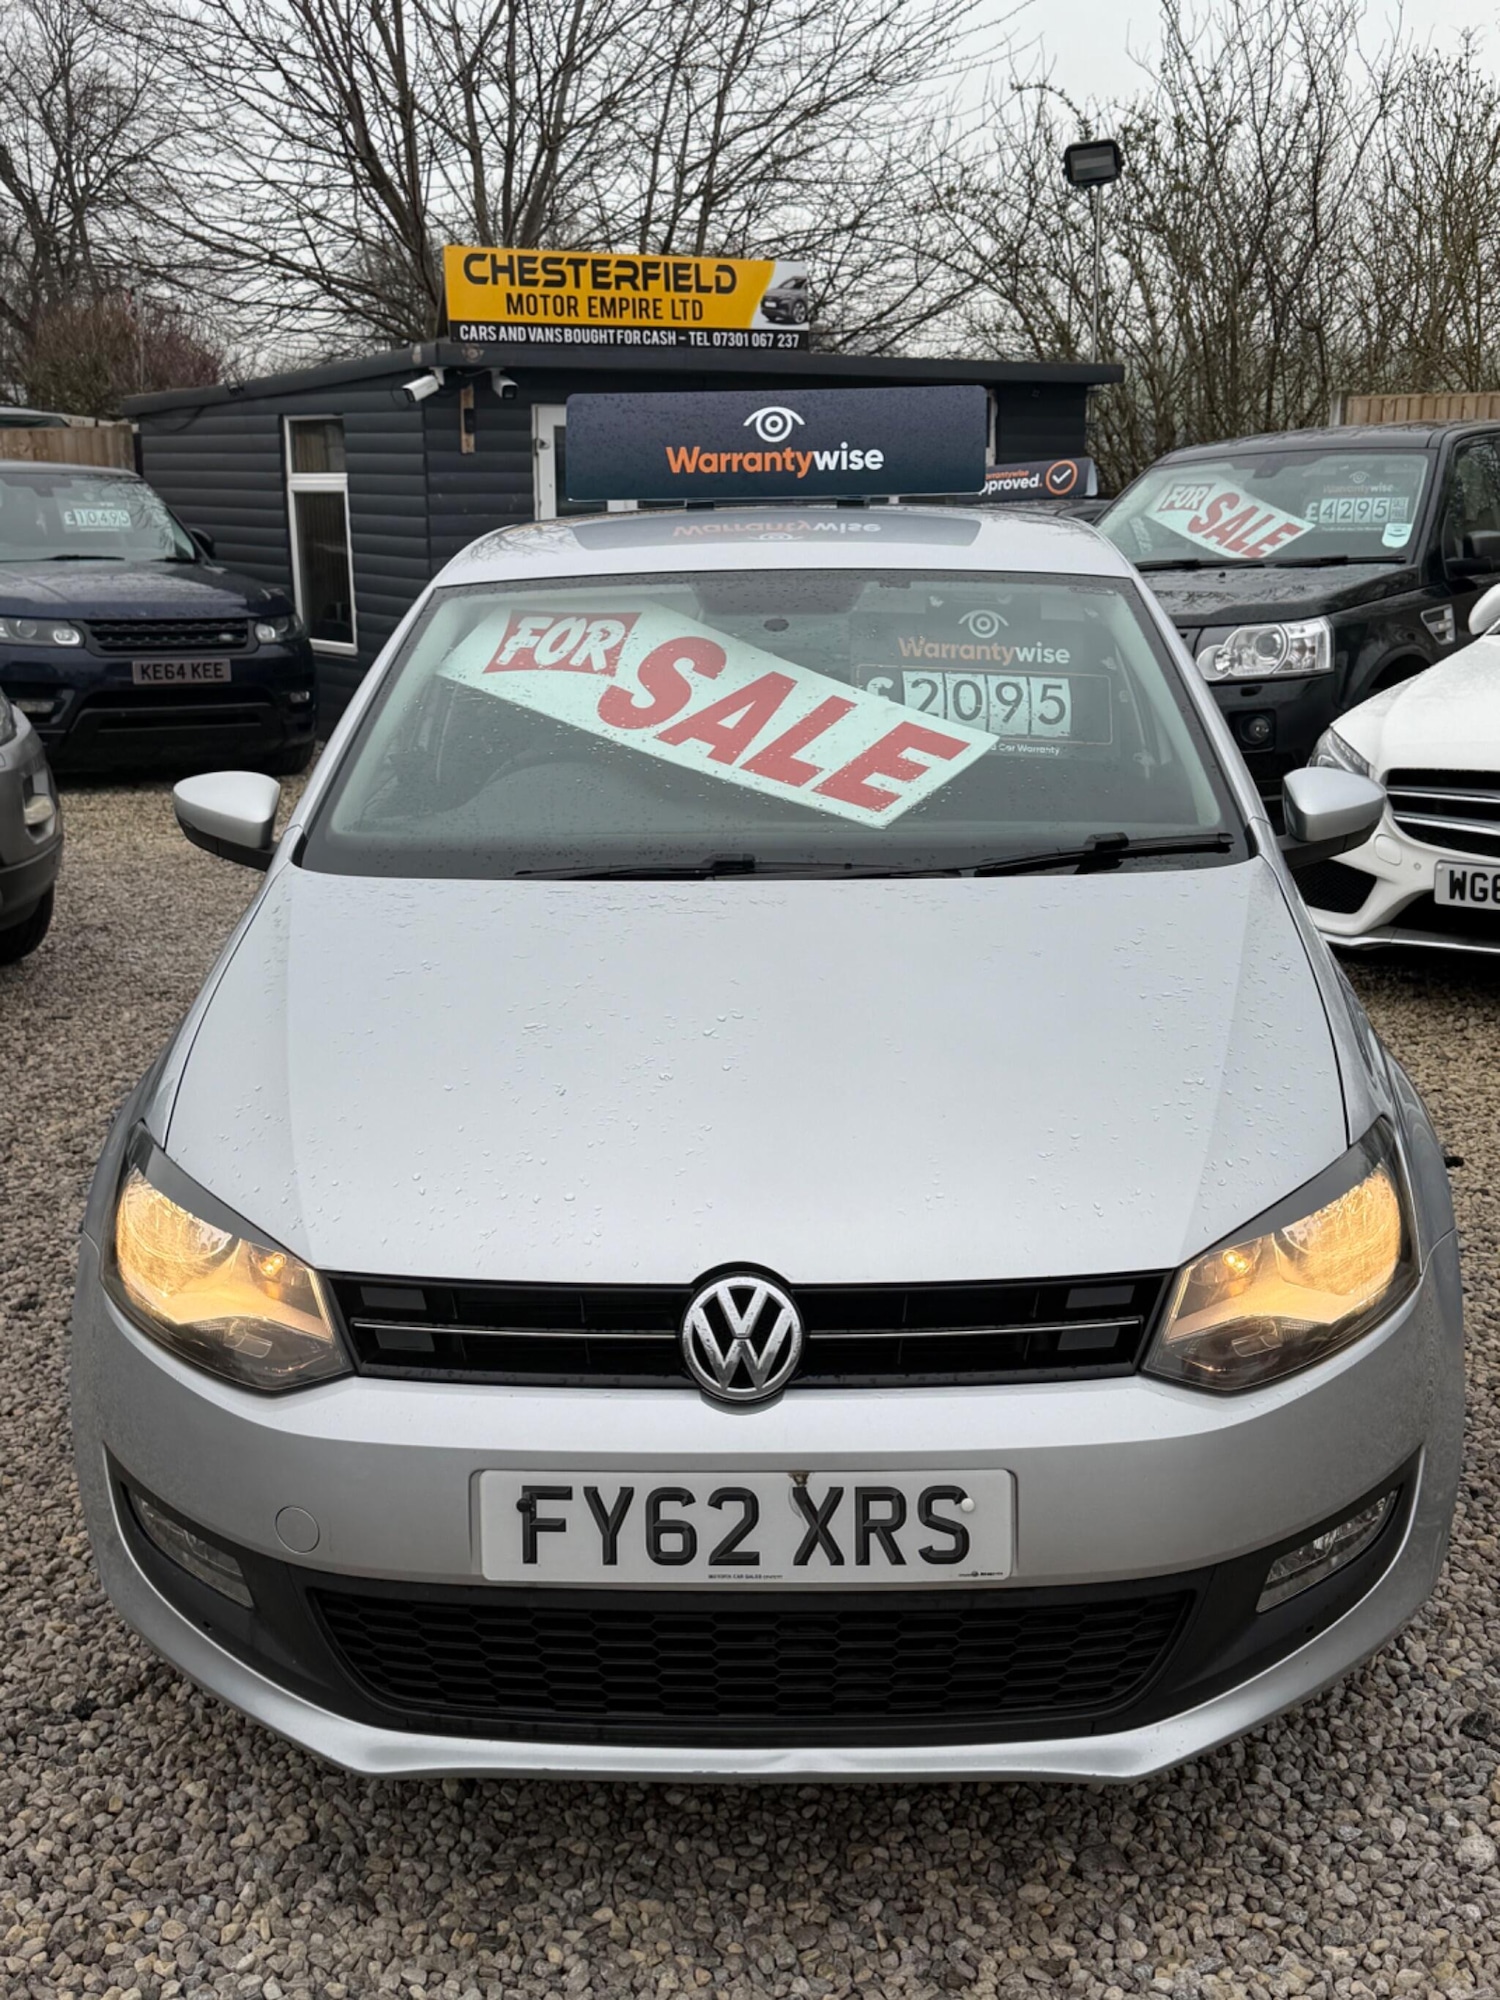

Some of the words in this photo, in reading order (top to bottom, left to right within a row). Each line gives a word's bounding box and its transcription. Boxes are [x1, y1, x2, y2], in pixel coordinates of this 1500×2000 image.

[463, 253, 738, 294] CHESTERFIELD
[506, 293, 579, 317] MOTOR
[587, 296, 663, 319] EMPIRE
[671, 299, 703, 321] LTD
[460, 325, 496, 341] CARS
[499, 326, 526, 341] AND
[528, 327, 562, 343] VANS
[564, 328, 615, 344] BOUGHT
[617, 329, 641, 345] FOR
[643, 330, 676, 345] CASH
[689, 332, 711, 346] TEL
[713, 332, 749, 347] 07301
[752, 334, 773, 347] 067
[777, 334, 799, 348] 237
[666, 442, 884, 478] Warrantywise
[1161, 486, 1208, 510] FOR
[1305, 501, 1387, 520] £4295
[1187, 492, 1304, 558] SALE
[497, 616, 626, 671] FOR
[898, 637, 1070, 665] Warrantywise
[141, 663, 186, 680] KE64
[191, 662, 224, 679] KEE
[598, 636, 970, 812] SALE
[521, 1485, 760, 1566] FY62
[792, 1484, 970, 1566] XRS
